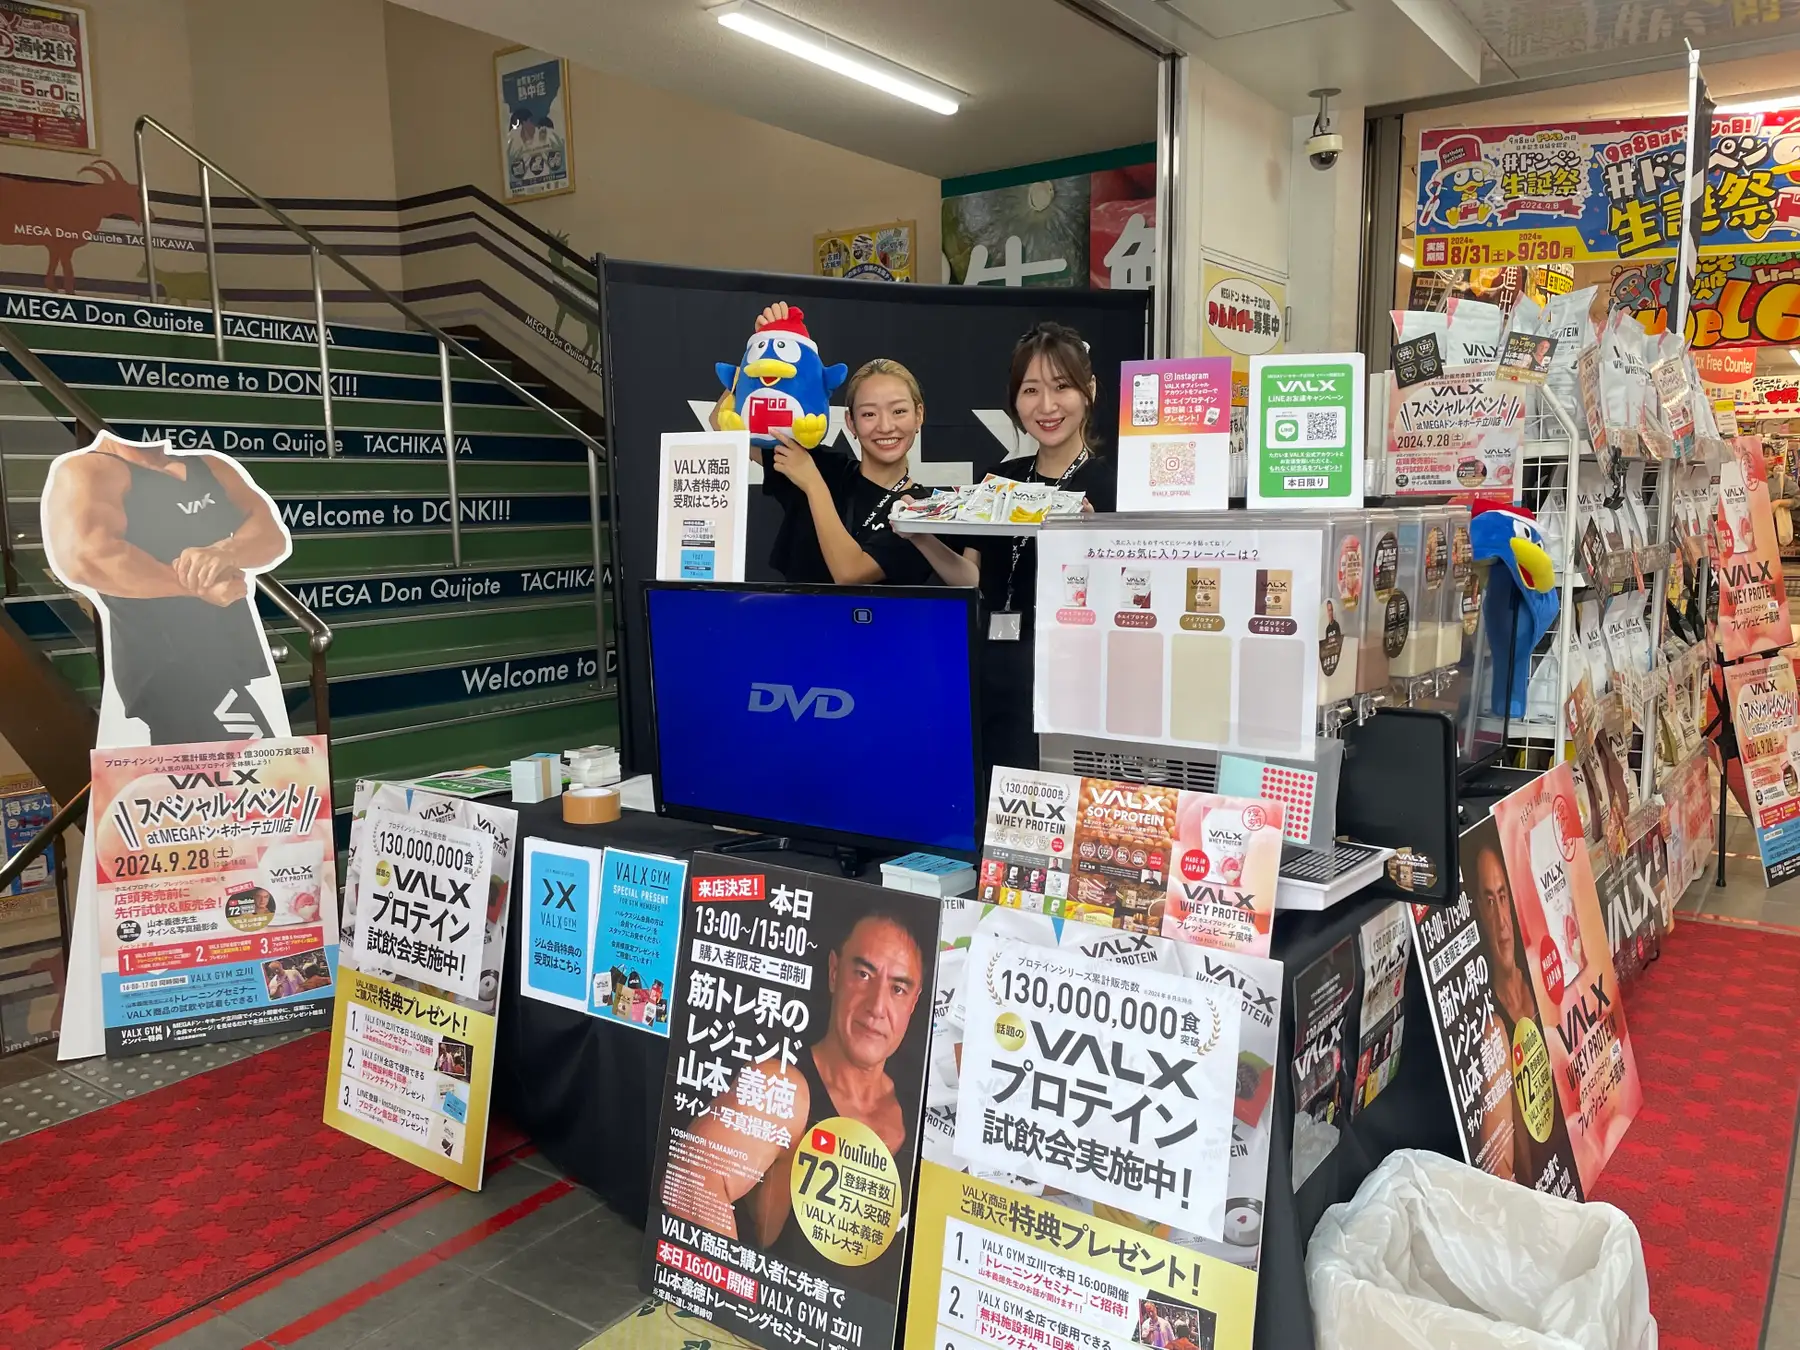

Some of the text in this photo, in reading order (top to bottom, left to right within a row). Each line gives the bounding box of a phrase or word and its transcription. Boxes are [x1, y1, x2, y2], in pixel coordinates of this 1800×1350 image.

[1501, 168, 1581, 200] 生誕祭
[1520, 201, 1559, 209] 2024.9.8
[14, 224, 52, 238] MEGA
[55, 227, 78, 240] Don
[82, 230, 122, 244] Quijote
[1451, 245, 1490, 265] 8/31
[1518, 241, 1561, 261] 9/30
[6, 297, 77, 322] MEGA
[85, 304, 125, 326] Don
[133, 308, 204, 334] Quijote
[525, 316, 563, 346] MEGA Don
[1706, 355, 1753, 374] Free Counter
[117, 361, 229, 390] Welcome
[238, 372, 259, 392] to
[1174, 373, 1209, 381] Instagram
[1276, 380, 1336, 393] VALX
[1164, 397, 1217, 405] ホエイプロテイン
[1165, 388, 1218, 396] アカウントをフォローで
[1431, 384, 1484, 396] VALX
[1412, 394, 1507, 418] スペシャルイベント
[1164, 414, 1199, 422] プレゼント!
[223, 430, 265, 452] Don
[1398, 434, 1449, 449] 2024.9.28
[674, 459, 730, 475] VALX 商品
[1062, 464, 1077, 480] VALX
[673, 479, 730, 493] 購入者特典の
[1288, 479, 1324, 487] 本日限り
[1723, 487, 1745, 498] VALX
[673, 495, 728, 509] 受取はこちら
[877, 494, 891, 508] VALX
[281, 503, 384, 528] Welcome
[394, 506, 414, 524] to
[863, 511, 876, 527] VALX
[1087, 548, 1259, 560] あなたのお気に入りフレーバーは?
[1722, 560, 1773, 588] VALX
[299, 579, 501, 610] MEGA Don Quijote
[461, 664, 569, 695] Welcome
[576, 658, 597, 679] to
[1750, 679, 1778, 695] VALX
[748, 682, 855, 722] DVD
[168, 769, 260, 790] VALX
[135, 783, 301, 825] スペシャルイベント
[419, 801, 455, 821] VALX
[998, 796, 1065, 821] VALX
[1090, 788, 1165, 813] VALX
[996, 814, 1026, 829] WHEY
[1026, 818, 1066, 835] PROTEIN
[1087, 807, 1164, 826] SOY PROTEIN
[1209, 829, 1243, 841] VALX
[115, 849, 210, 878] 2024.9.28
[1184, 854, 1199, 865] MADE
[1184, 863, 1205, 874] JAPAN
[269, 865, 312, 877] VALX
[616, 861, 670, 886] VALX GYM
[1540, 861, 1564, 890] VALX
[115, 888, 190, 906] 店頭発売前に
[393, 864, 472, 909] VALX
[613, 884, 668, 904] SPECIAL PRESENT
[698, 880, 759, 898] 来店決定!
[1182, 882, 1255, 911] VALX
[115, 897, 222, 920] 先行試飲&販売会!
[229, 907, 240, 915] 72
[640, 901, 661, 912] MEMBERS
[769, 884, 814, 921] 本日
[1179, 900, 1255, 924] WHEY PROTEIN
[147, 916, 198, 928] 山本義徳先生
[372, 891, 470, 944] プロテイン
[541, 911, 577, 929] VALX GYM
[147, 922, 218, 937] サイン&写真撮影会
[1176, 921, 1254, 944] フレッシュピーチ風味
[196, 945, 207, 963] 2.
[260, 937, 272, 954] 3.
[366, 926, 466, 981] 試飲会実施中!
[534, 937, 582, 958] ジム会員特典の
[123, 954, 134, 972] 1.
[534, 951, 581, 975] 受取はこちら
[190, 967, 254, 983] VALX GYM 立川
[1018, 956, 1140, 994] プロテインシリーズ累計販売数
[1546, 965, 1561, 991] JAPAN
[378, 986, 468, 1037] 特典プレゼント!
[687, 969, 810, 1033] 筋トレ界の
[126, 1011, 152, 1020] VALX
[351, 1010, 359, 1033] 1.
[1556, 973, 1612, 1057] VALX
[121, 1026, 162, 1038] VALX GYM
[121, 1034, 163, 1046] メンバー特典
[995, 1022, 1025, 1041] 話題の
[686, 1013, 803, 1074] レジェンド
[1565, 1011, 1617, 1091] WHEY PROTEIN
[347, 1047, 355, 1069] 2.
[383, 1057, 425, 1081] 全店で使用できる
[1029, 1019, 1200, 1101] VALX
[343, 1086, 351, 1108] 3.
[1515, 1065, 1536, 1112] 72
[991, 1058, 1198, 1151] プロテイン
[670, 1127, 706, 1146] YOSHINORI
[708, 1140, 748, 1161] YAMAMOTO
[838, 1137, 887, 1172] YouTube
[981, 1108, 1194, 1210] 試飲会実施中!
[798, 1151, 840, 1206] 72
[844, 1172, 890, 1201] 登録者数
[839, 1194, 891, 1228] 万人突破
[961, 1199, 1008, 1226] ご購入で
[661, 1214, 701, 1248] VALX
[956, 1231, 969, 1264] 1.
[982, 1238, 1025, 1264] VALX GYM
[1008, 1201, 1202, 1298] 特典プレゼント!
[978, 1290, 1023, 1318] VALX GYM
[759, 1284, 863, 1347] VALX GYM 立川
